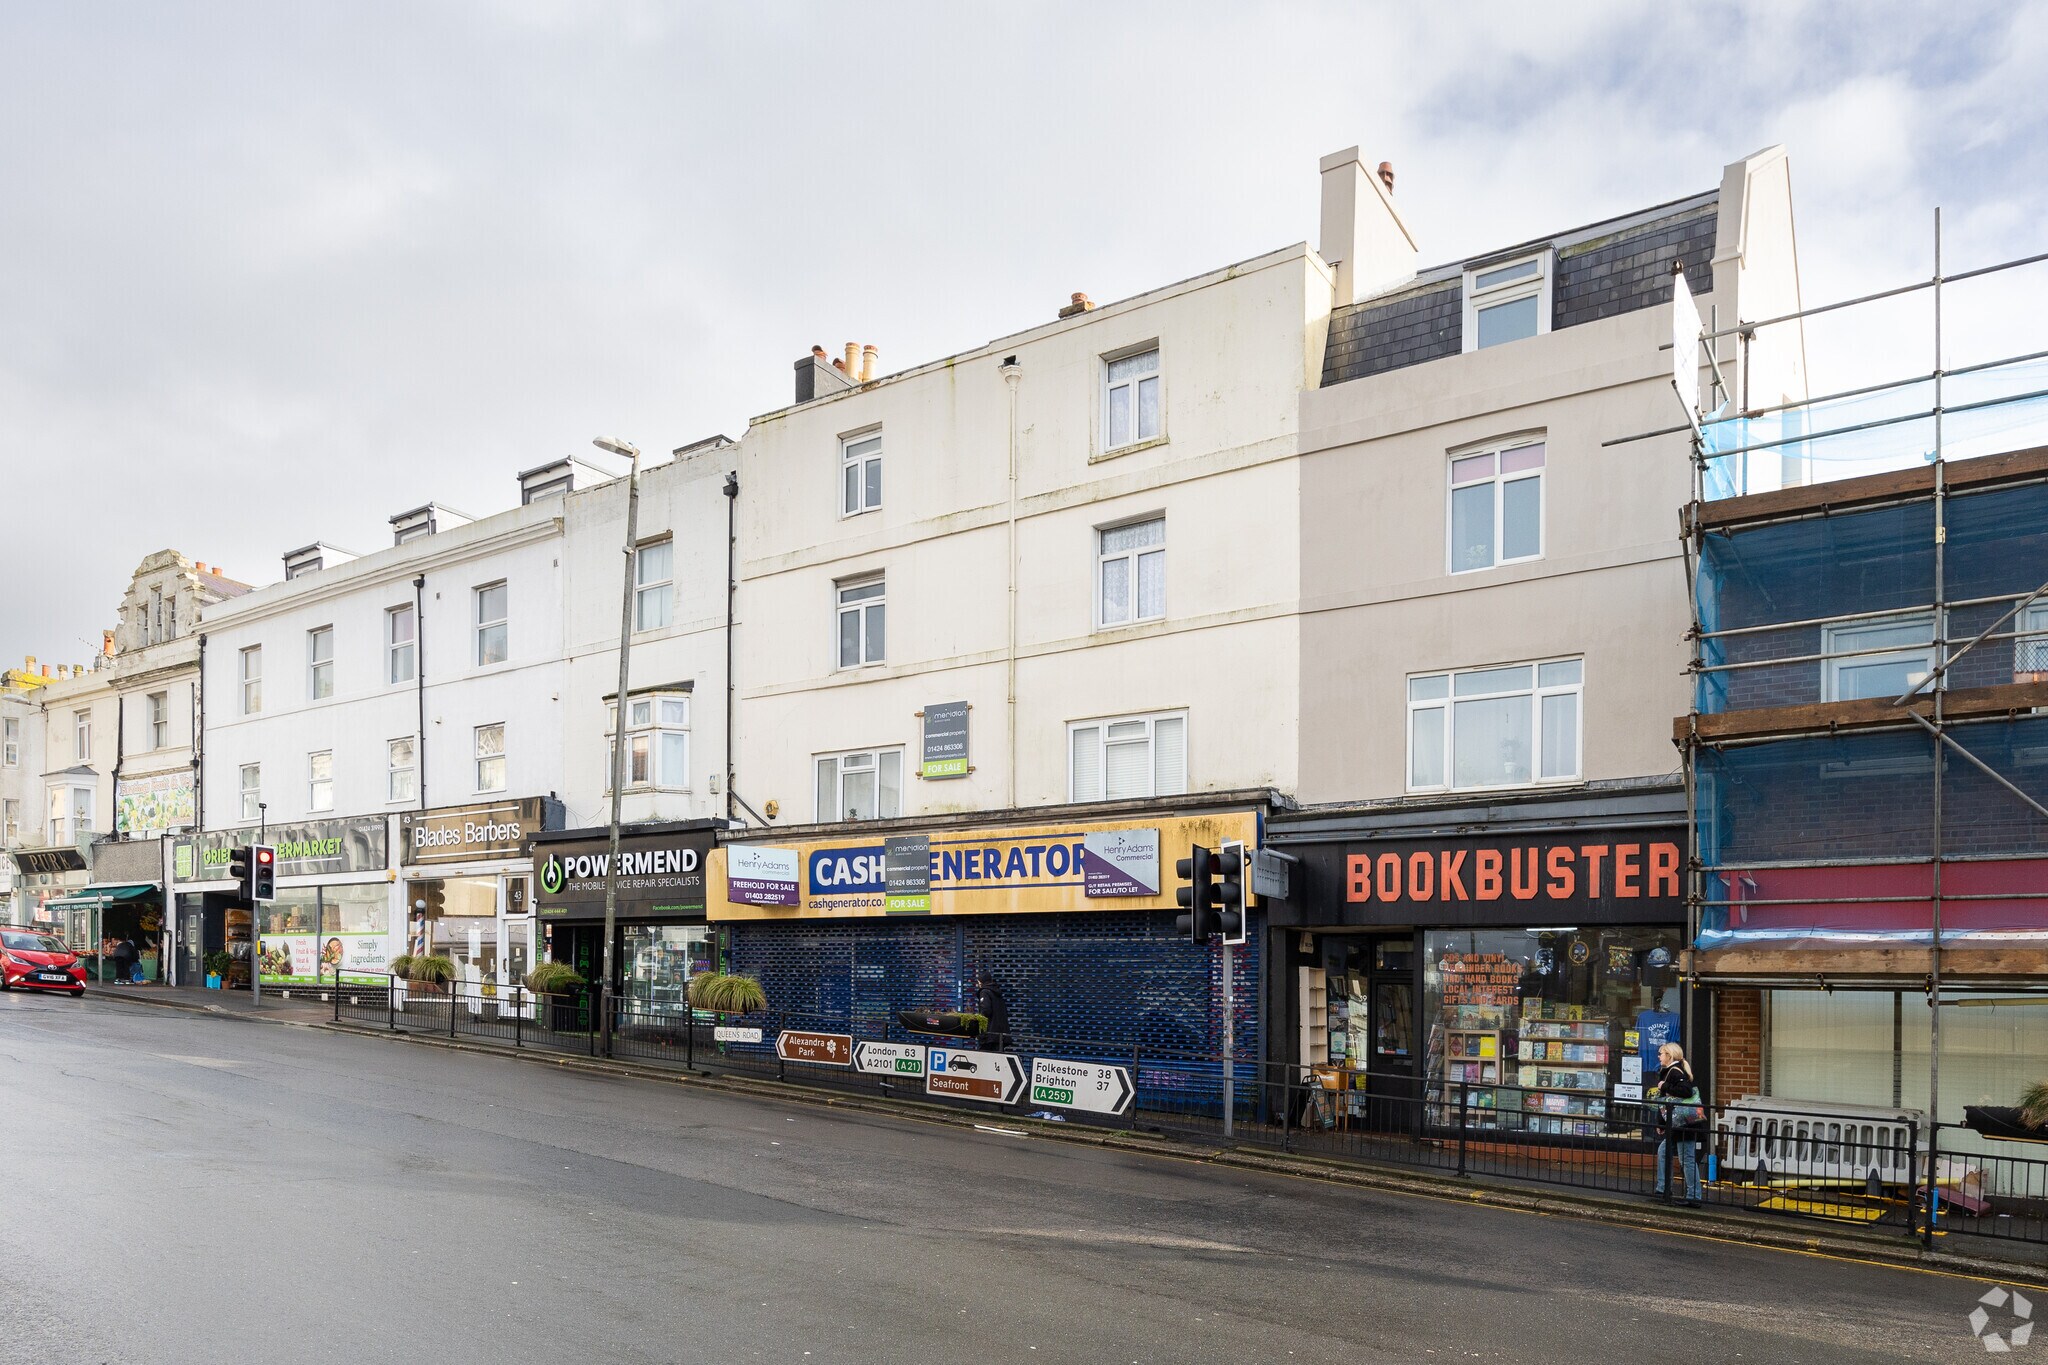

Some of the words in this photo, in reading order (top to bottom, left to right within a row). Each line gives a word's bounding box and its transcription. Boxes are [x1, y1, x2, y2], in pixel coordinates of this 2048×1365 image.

[934, 710, 966, 719] meridian
[944, 743, 963, 751] 863306
[928, 765, 942, 773] FOR
[944, 763, 961, 772] SALE
[403, 816, 411, 824] 43
[416, 825, 460, 848] Blades
[465, 820, 520, 843] Barbers
[895, 844, 928, 852] meridian
[816, 856, 886, 886] CASH
[930, 843, 1085, 881] ENERATOR
[1346, 842, 1680, 903] BOOKBUSTER
[568, 882, 581, 890] THE
[582, 881, 606, 890] MOBILE
[616, 880, 631, 889] VICE
[633, 879, 656, 888] REPAIR
[658, 876, 700, 888] SPECIALISTS
[733, 881, 765, 890] FREEHOLD
[766, 882, 779, 890] FOR
[780, 883, 795, 891] SALE
[514, 890, 522, 900] 43
[809, 898, 886, 912] cashgenerator.co.
[890, 900, 906, 908] FOR
[907, 900, 924, 908] SALE
[358, 940, 378, 952] Simply
[350, 954, 386, 966] Ingredients
[1463, 953, 1479, 962] AND
[1482, 954, 1505, 962] VINYL
[1494, 964, 1523, 972] BOOKS
[1490, 975, 1519, 984] BOOKS
[1444, 985, 1468, 994] LOCAL
[1472, 986, 1514, 994] INTEREST
[1444, 996, 1468, 1004] GIFTS
[1470, 996, 1486, 1004] AND
[716, 1030, 740, 1039] QUEENS
[742, 1032, 760, 1040] ROAD
[789, 1036, 824, 1047] Alexandra
[798, 1047, 815, 1057] Park
[868, 1046, 896, 1056] London
[905, 1049, 916, 1058] 63
[933, 1054, 944, 1069] P
[1036, 1062, 1088, 1077] Folkestone
[1098, 1069, 1111, 1079] 38
[933, 1078, 969, 1091] Seafront
[1036, 1074, 1076, 1088] Brighton
[1096, 1081, 1109, 1091] 37
